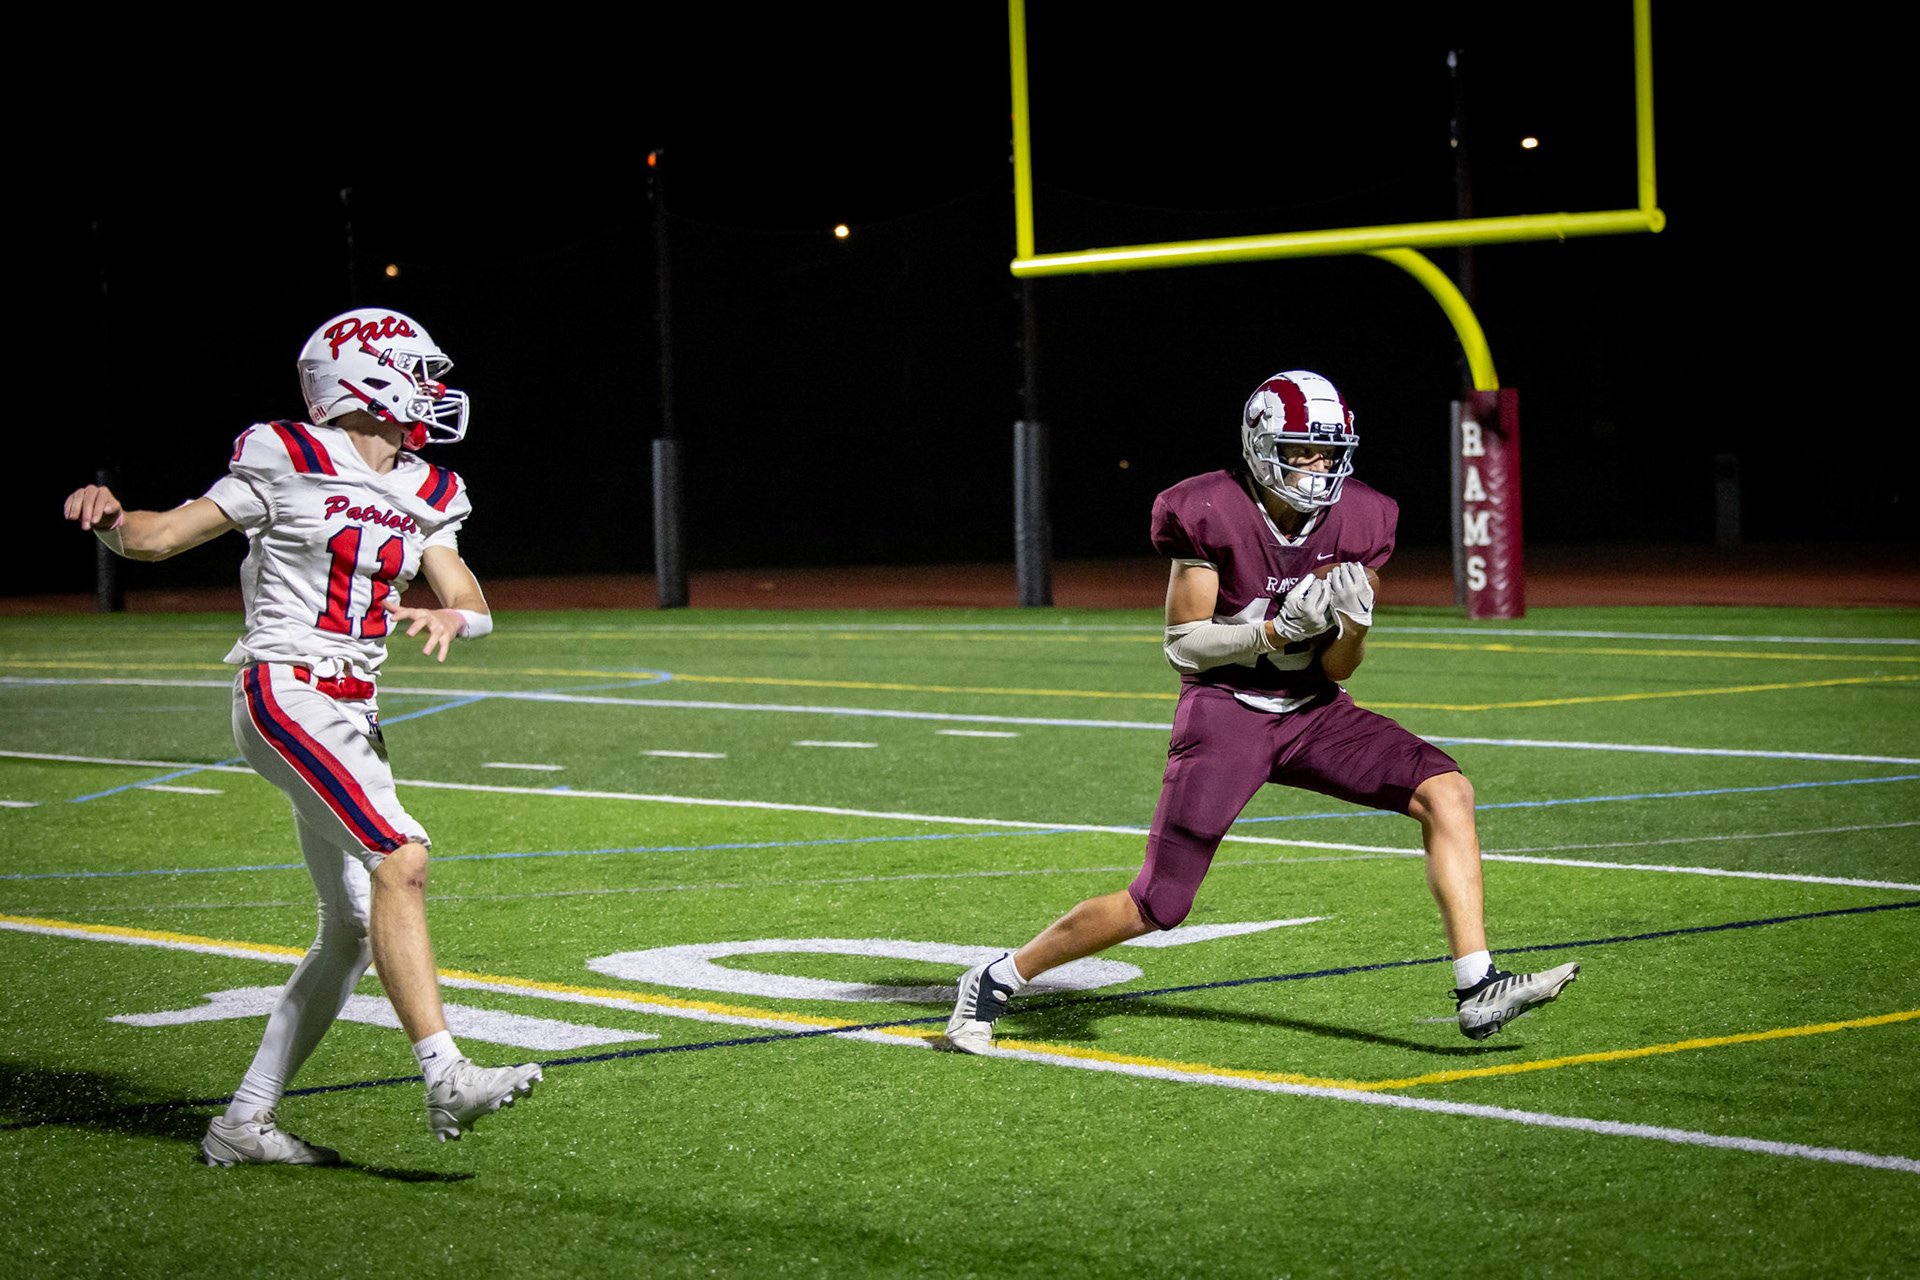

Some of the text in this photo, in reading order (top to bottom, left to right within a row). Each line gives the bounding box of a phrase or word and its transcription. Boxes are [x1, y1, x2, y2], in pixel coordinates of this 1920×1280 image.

[323, 315, 418, 360] Pats
[324, 496, 417, 534] Patriots
[1461, 421, 1492, 591] RAMS
[315, 525, 404, 639] 11
